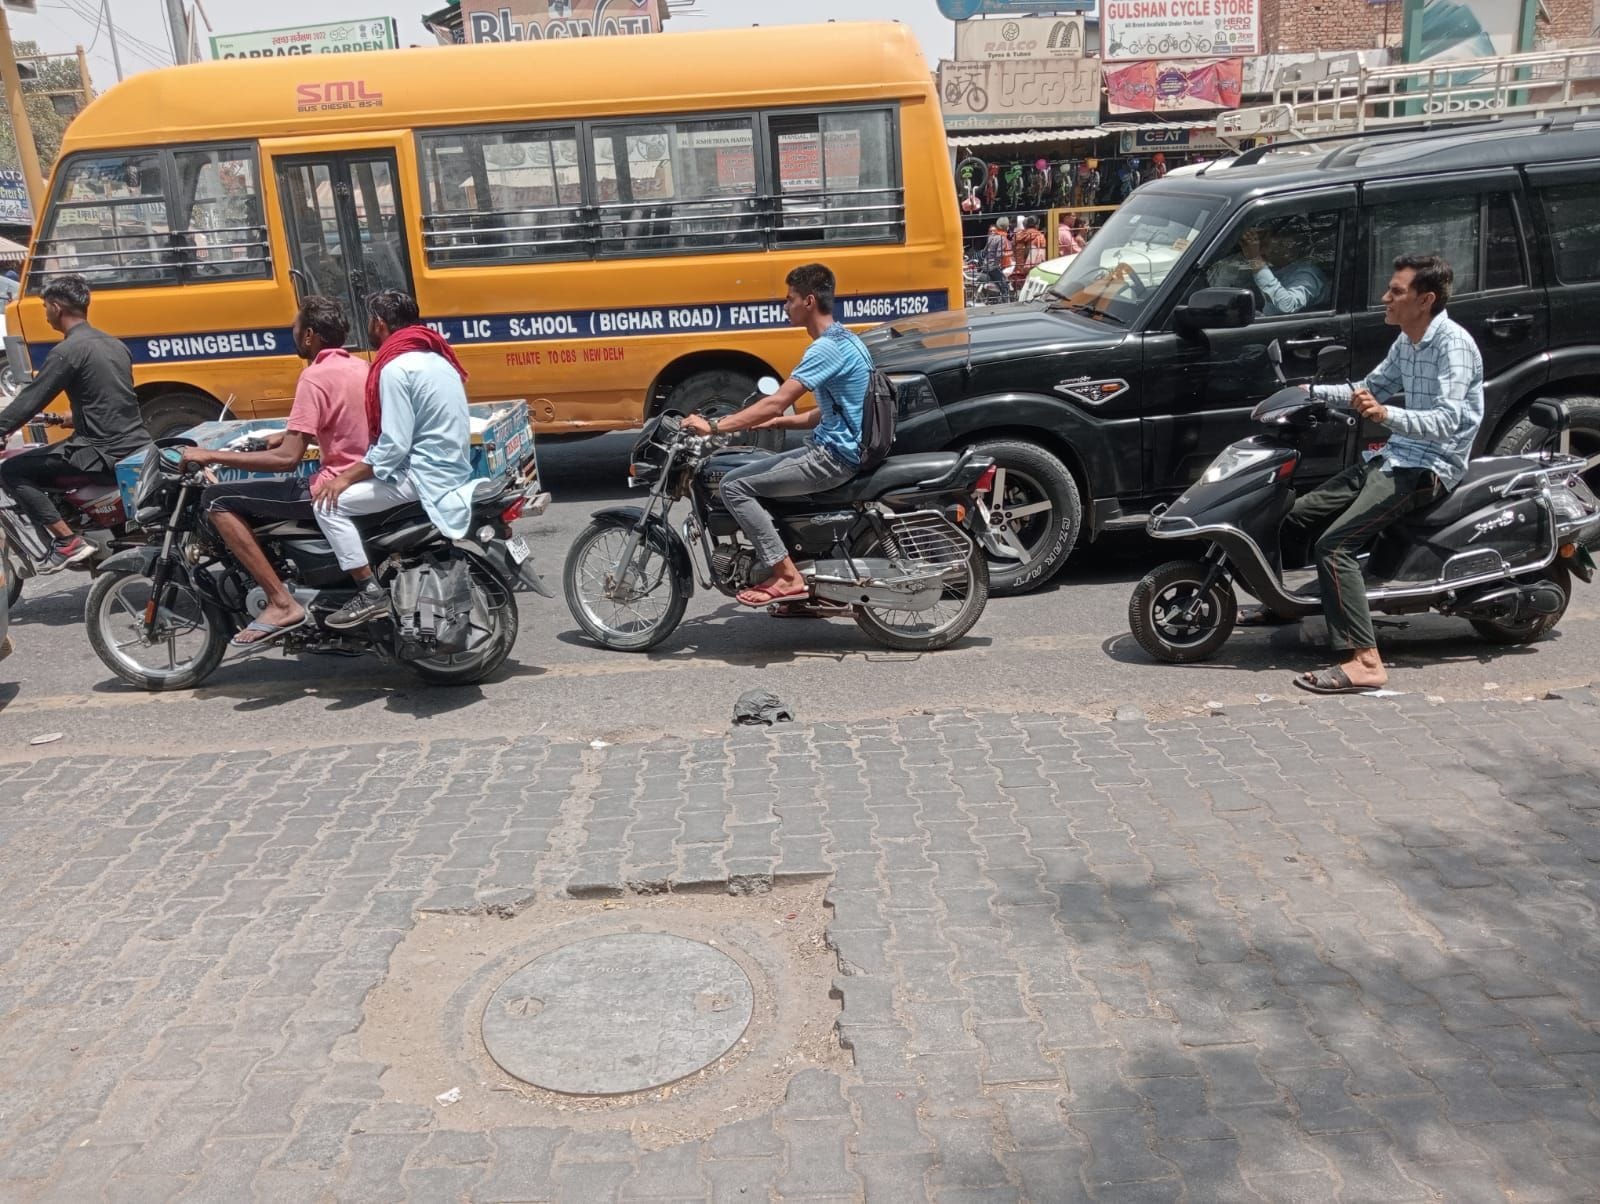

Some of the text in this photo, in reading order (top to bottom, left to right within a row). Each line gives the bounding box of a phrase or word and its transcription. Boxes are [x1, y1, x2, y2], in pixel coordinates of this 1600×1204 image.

[1108, 0, 1254, 20] GULSHAN CYCLE STORE
[320, 41, 384, 54] GARDEN
[984, 40, 1039, 52] RALCO
[296, 80, 383, 105] SML
[297, 104, 318, 113] BUS
[321, 101, 354, 111] DIESEL
[1144, 131, 1182, 142] CEAT
[509, 315, 577, 337] SCHOOL
[730, 305, 791, 325] FATEHA
[843, 296, 929, 317] M.94666-15262
[147, 332, 277, 358] SPRINGBELLS
[548, 352, 558, 363] TO
[560, 350, 577, 363] CBS
[583, 349, 601, 361] NEW
